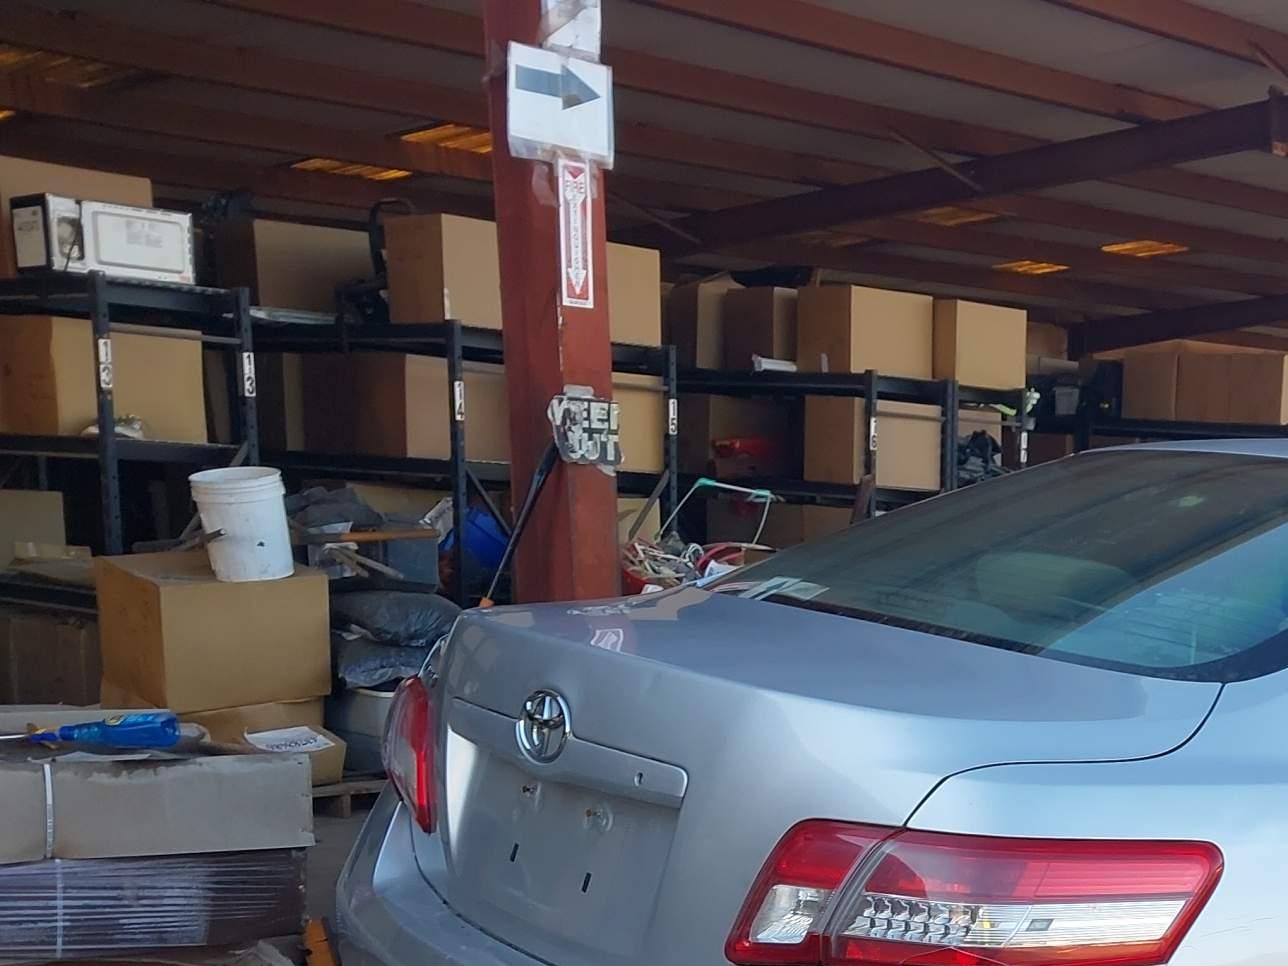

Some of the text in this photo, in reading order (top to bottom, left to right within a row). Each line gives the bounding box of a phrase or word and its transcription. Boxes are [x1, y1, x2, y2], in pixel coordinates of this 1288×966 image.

[245, 354, 255, 395] 13
[456, 382, 464, 419] 14
[669, 400, 677, 433] 15
